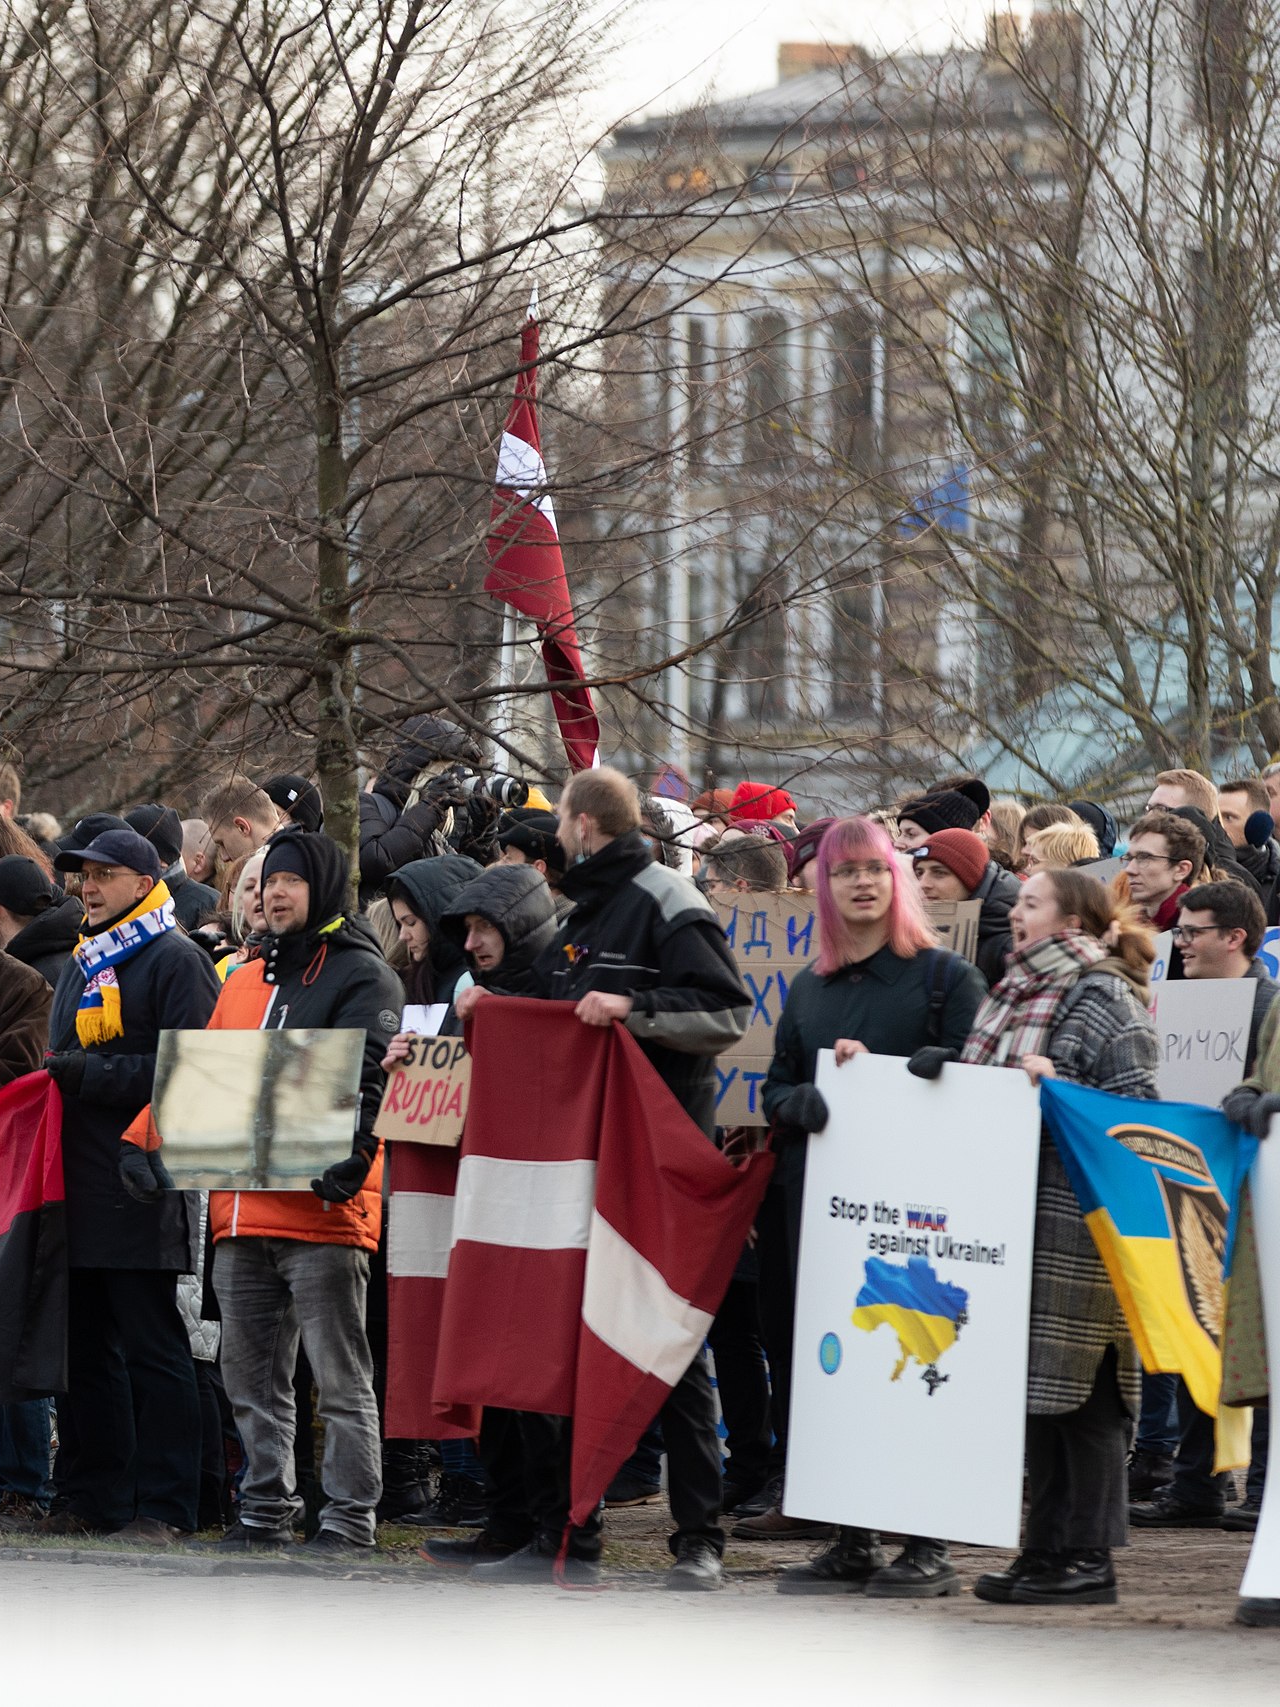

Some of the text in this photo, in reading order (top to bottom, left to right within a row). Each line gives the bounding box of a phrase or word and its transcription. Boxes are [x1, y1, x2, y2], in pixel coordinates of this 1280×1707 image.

[402, 1037, 467, 1070] STOP
[829, 1195, 949, 1233] Stop the WAR
[868, 1230, 1007, 1266] against Ukraine!
